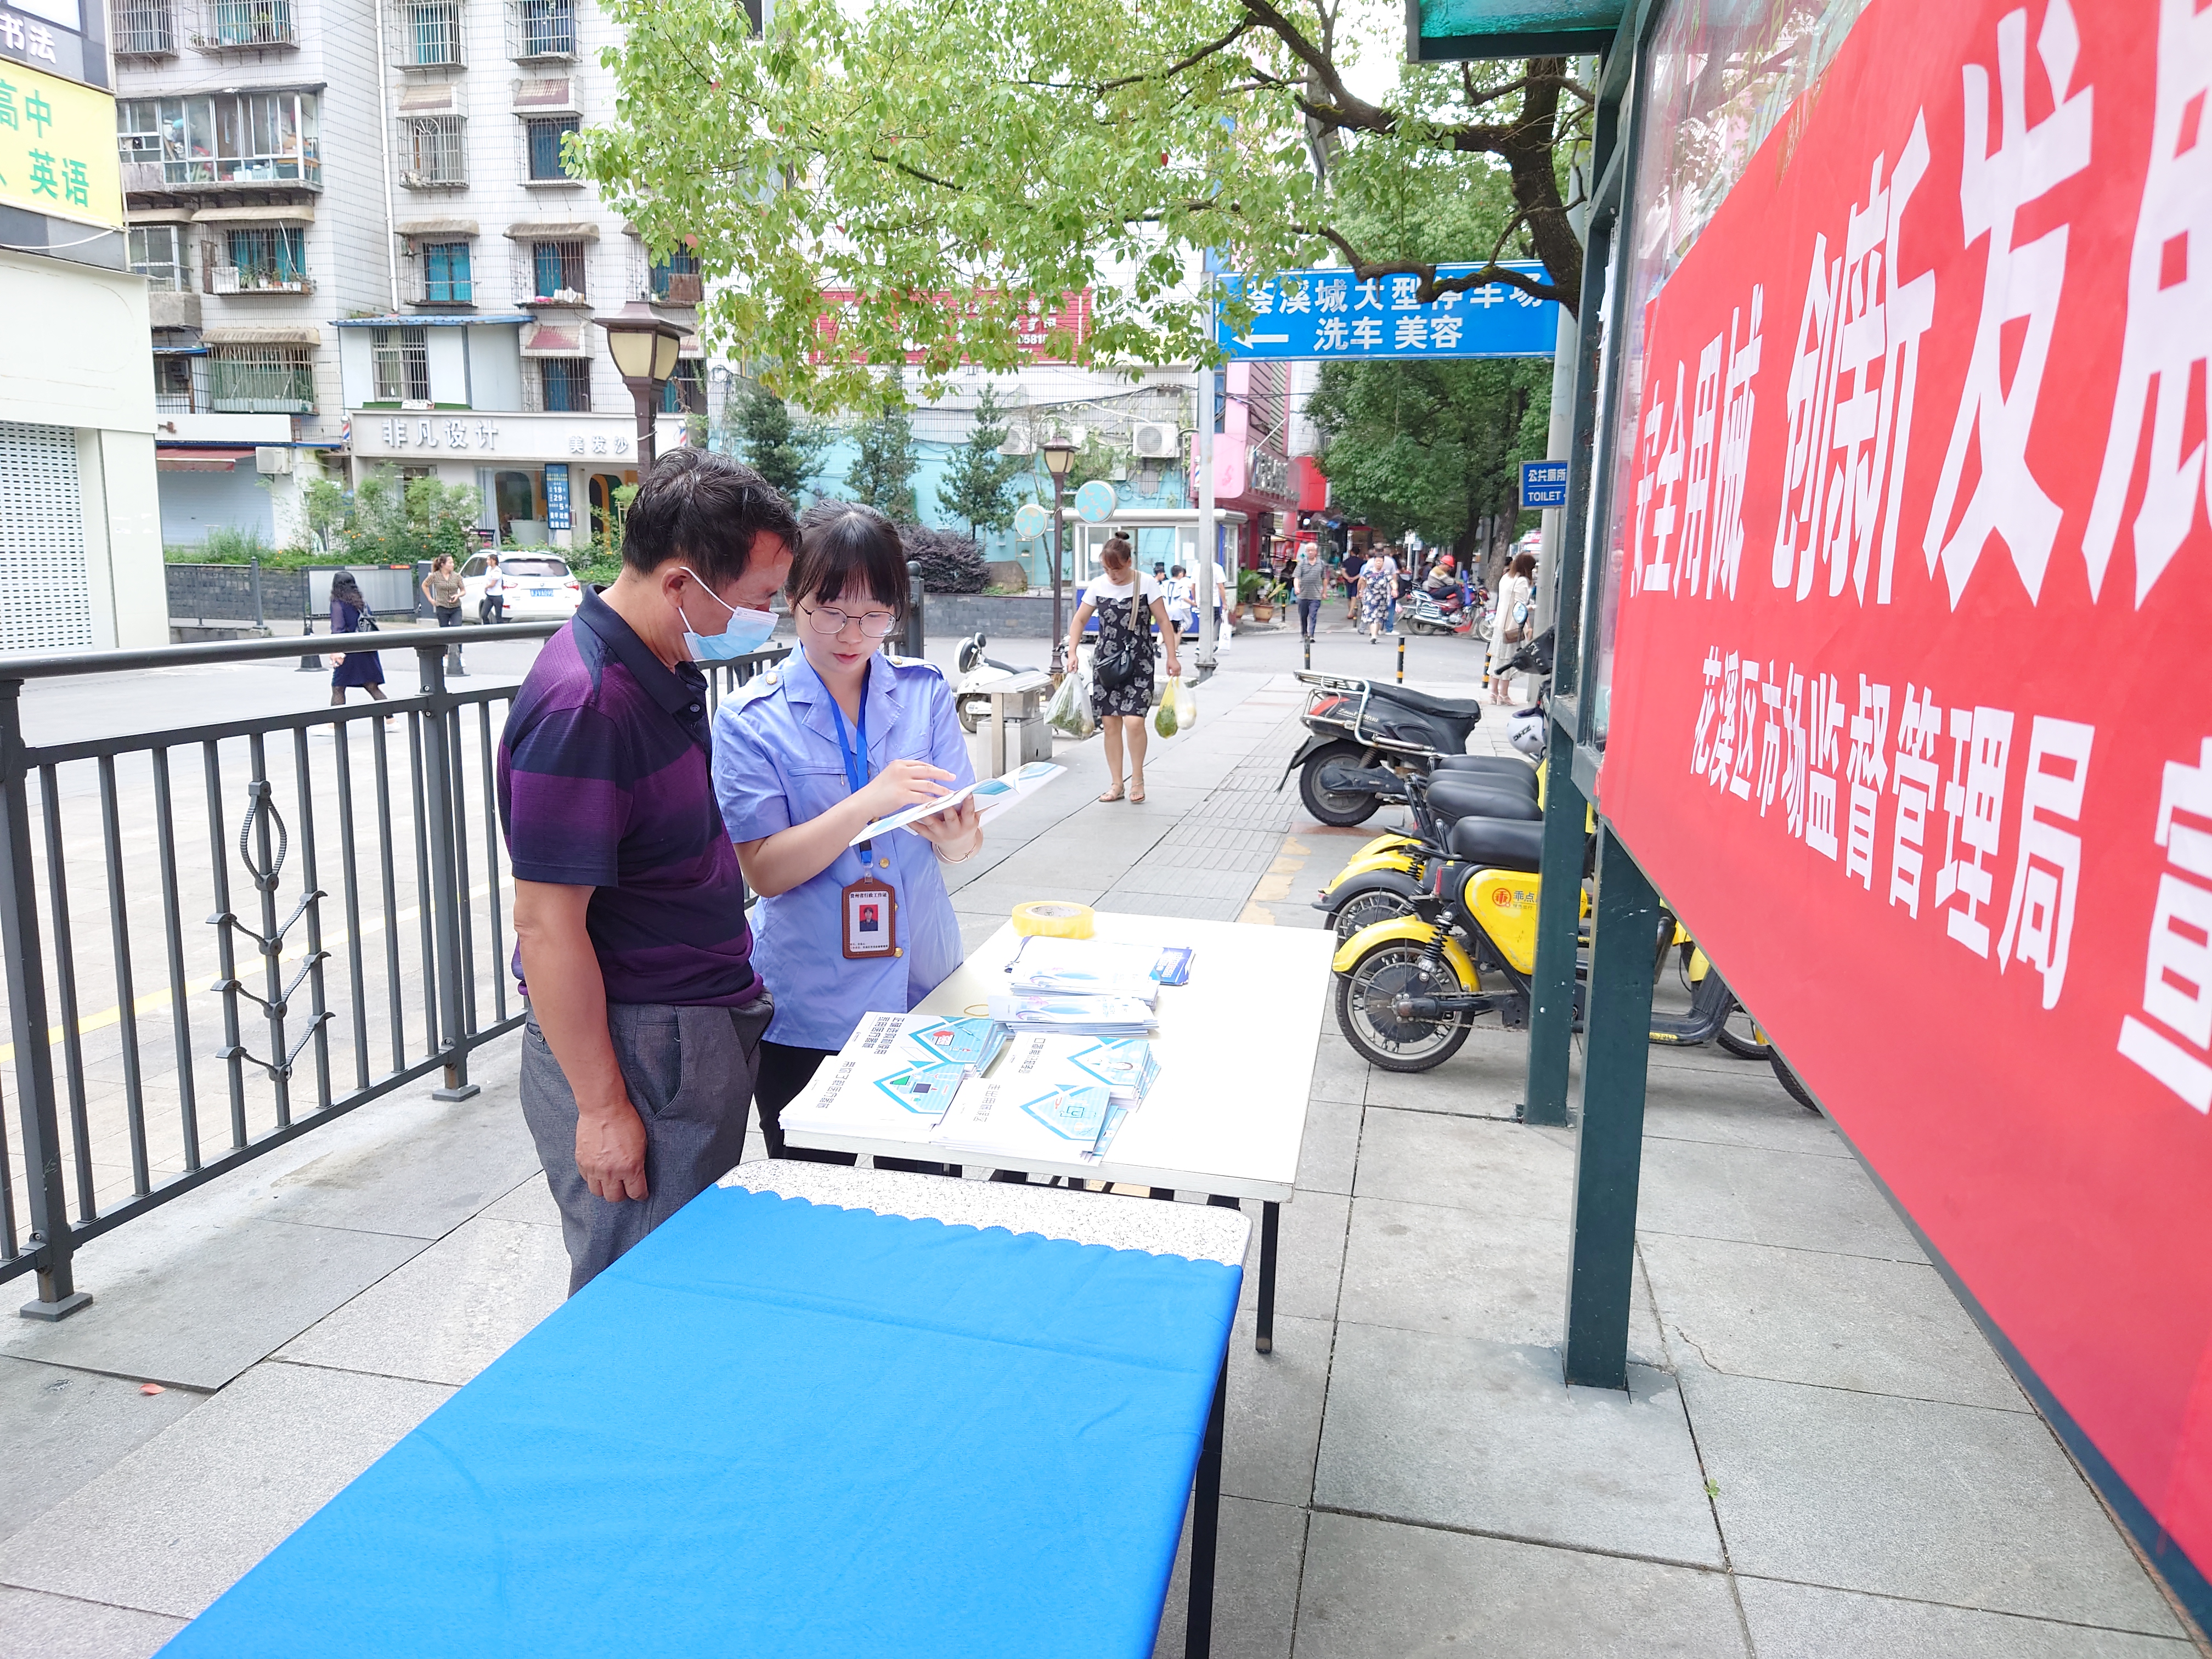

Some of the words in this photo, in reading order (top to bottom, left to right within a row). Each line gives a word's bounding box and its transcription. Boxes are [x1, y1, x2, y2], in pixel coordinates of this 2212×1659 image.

[0, 13, 57, 64] 书法
[0, 79, 53, 139] 高中
[1313, 316, 1383, 351] 洗车
[1394, 314, 1463, 350] 美容
[382, 419, 499, 450] 非凡设计
[570, 436, 628, 454] 美发沙
[1630, 283, 1763, 601] 安全用械
[1528, 468, 1566, 482] 公共厕所
[1527, 491, 1561, 501] TOILET
[1690, 645, 2095, 1010] 花溪区市场监督管理局
[1513, 890, 1537, 902] 乖点
